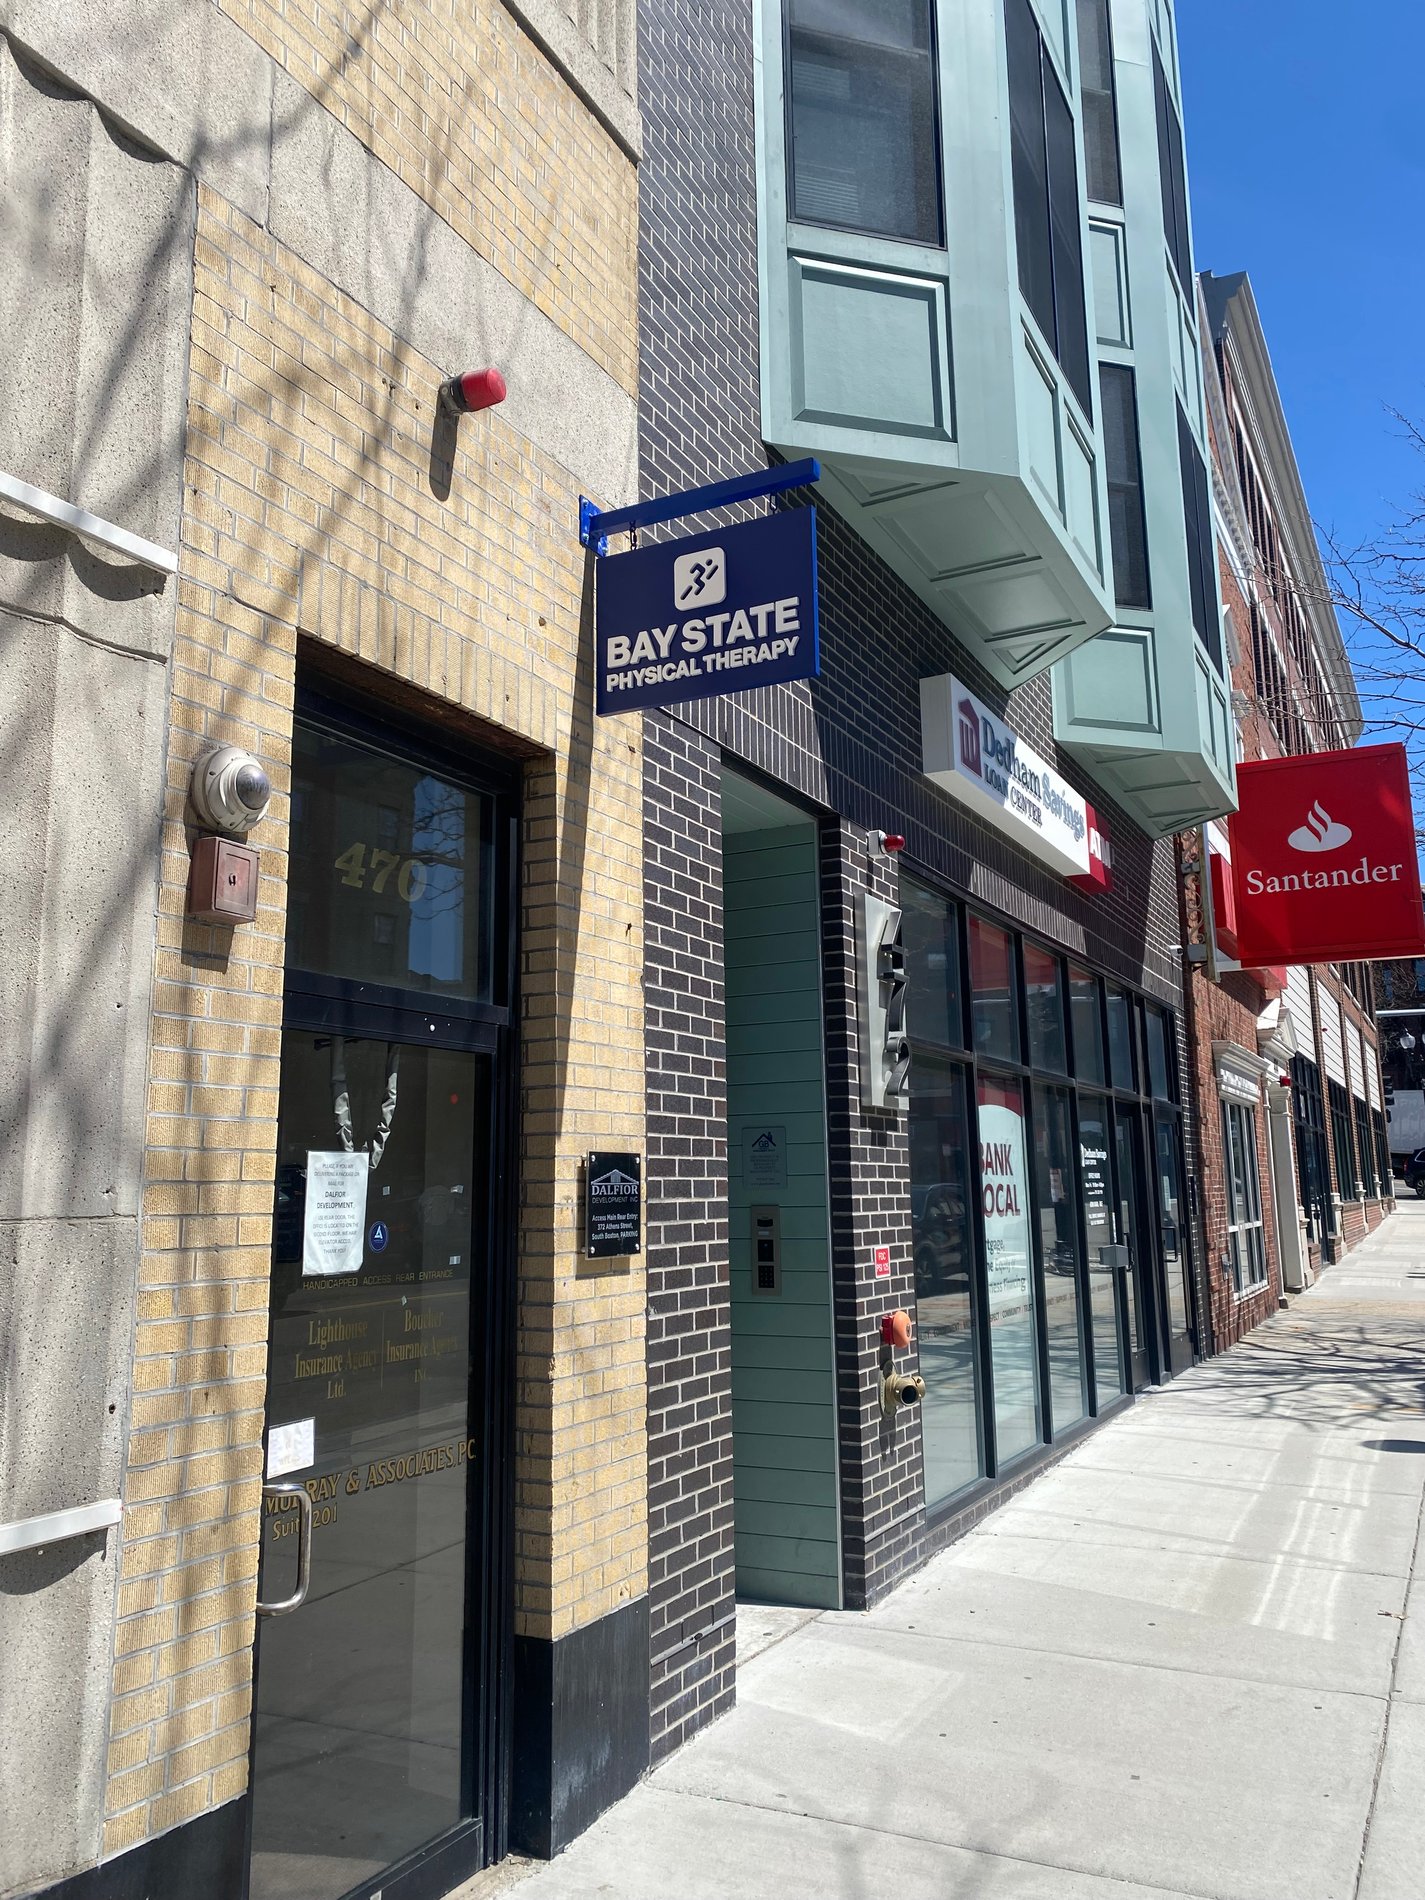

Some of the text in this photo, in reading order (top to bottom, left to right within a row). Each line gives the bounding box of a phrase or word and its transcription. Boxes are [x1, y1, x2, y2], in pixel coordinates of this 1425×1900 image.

[606, 596, 800, 669] BAY STATE
[606, 636, 799, 692] PHYSICAL THERAPY
[981, 715, 1085, 842] Dedham Savings
[984, 763, 1043, 827] LOAN CENTER
[334, 842, 427, 902] 470
[1247, 857, 1403, 895] Santander
[591, 1184, 639, 1196] DALFIOR
[592, 1196, 628, 1204] DEVELOPMENT
[982, 1183, 1021, 1218] OCAL
[303, 1268, 453, 1291] HANDICAPPED ACCESS REAR ENTRANCE
[308, 1317, 368, 1351] Lighthouse
[294, 1353, 343, 1379] Insurance
[386, 1340, 428, 1363] Insurance
[327, 1379, 346, 1399] Ltd.
[345, 1468, 360, 1494] &
[272, 1504, 339, 1542] Suit 201
